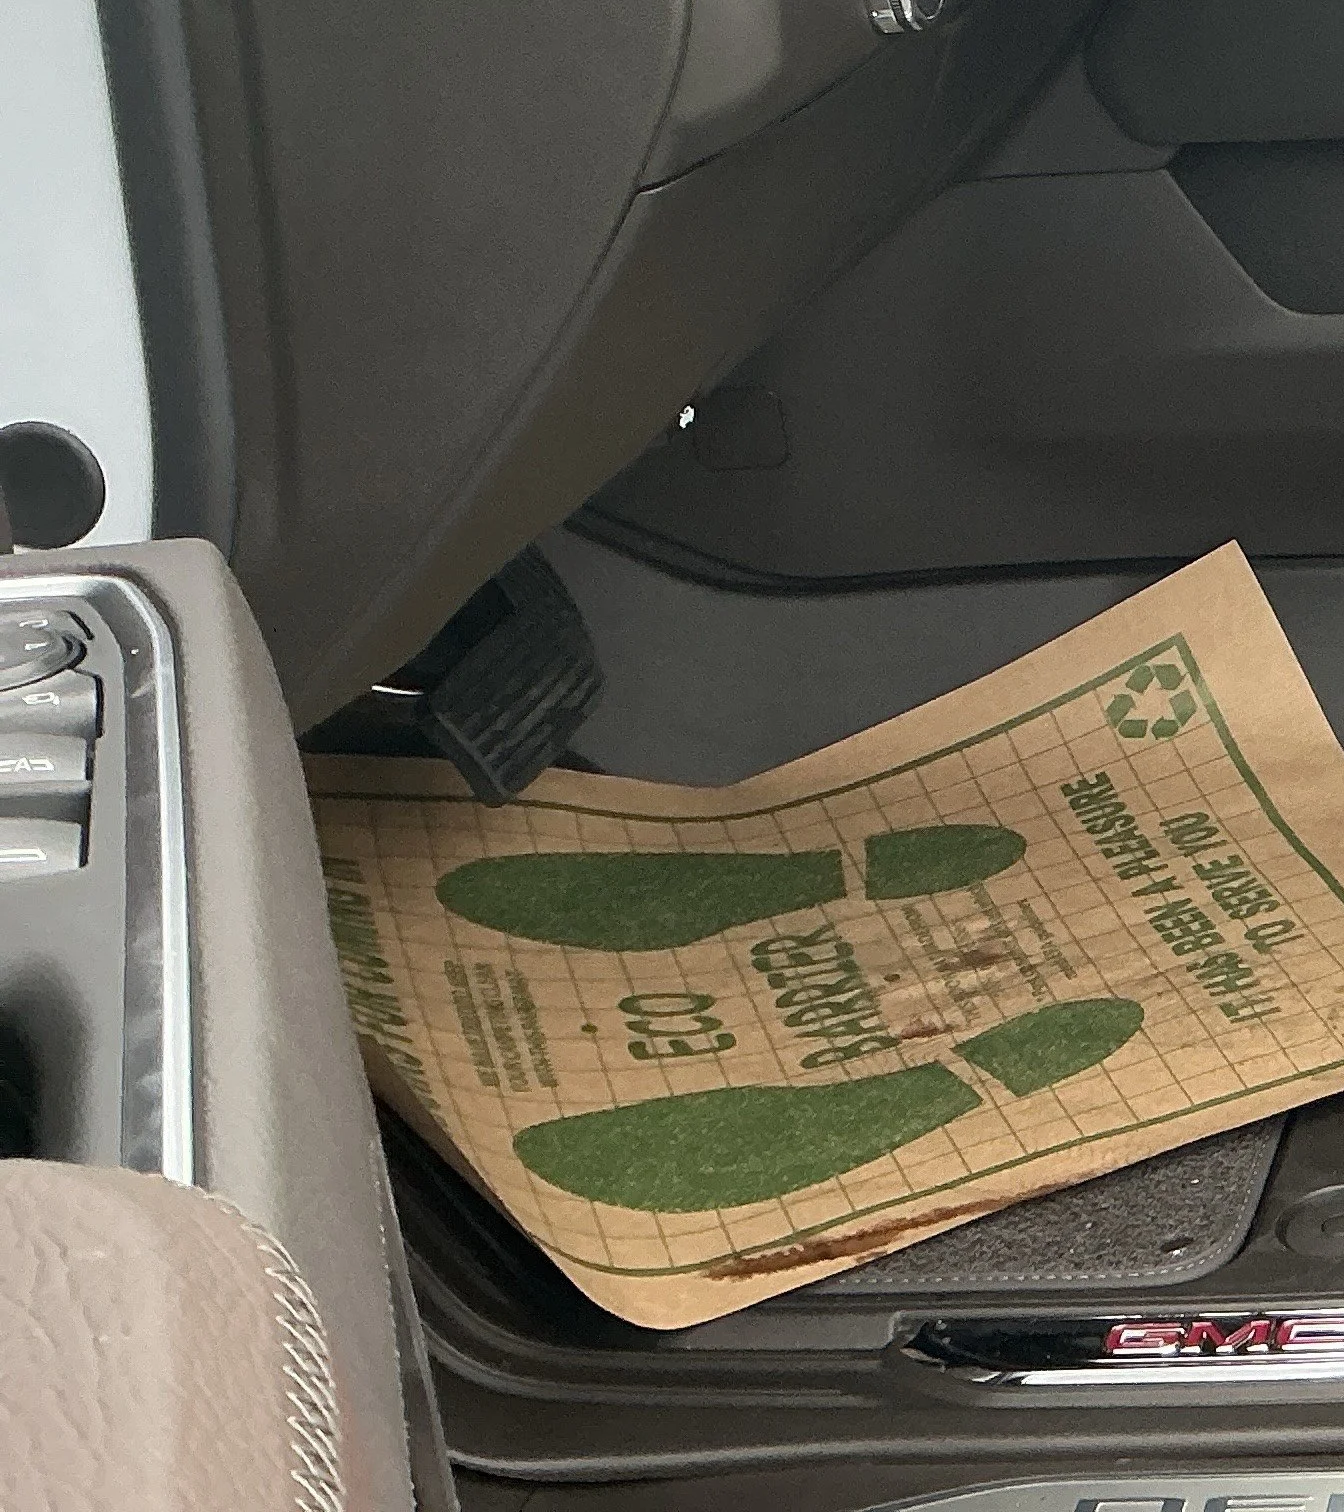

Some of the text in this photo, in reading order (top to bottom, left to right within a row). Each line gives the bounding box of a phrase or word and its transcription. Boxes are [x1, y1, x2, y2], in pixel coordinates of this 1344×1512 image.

[1060, 771, 1283, 1024] IT HAS BEEN A PLEASURE
[1159, 812, 1305, 955] TO SERVE YOU
[617, 992, 737, 1061] ECO
[750, 922, 902, 1070] BARRIER
